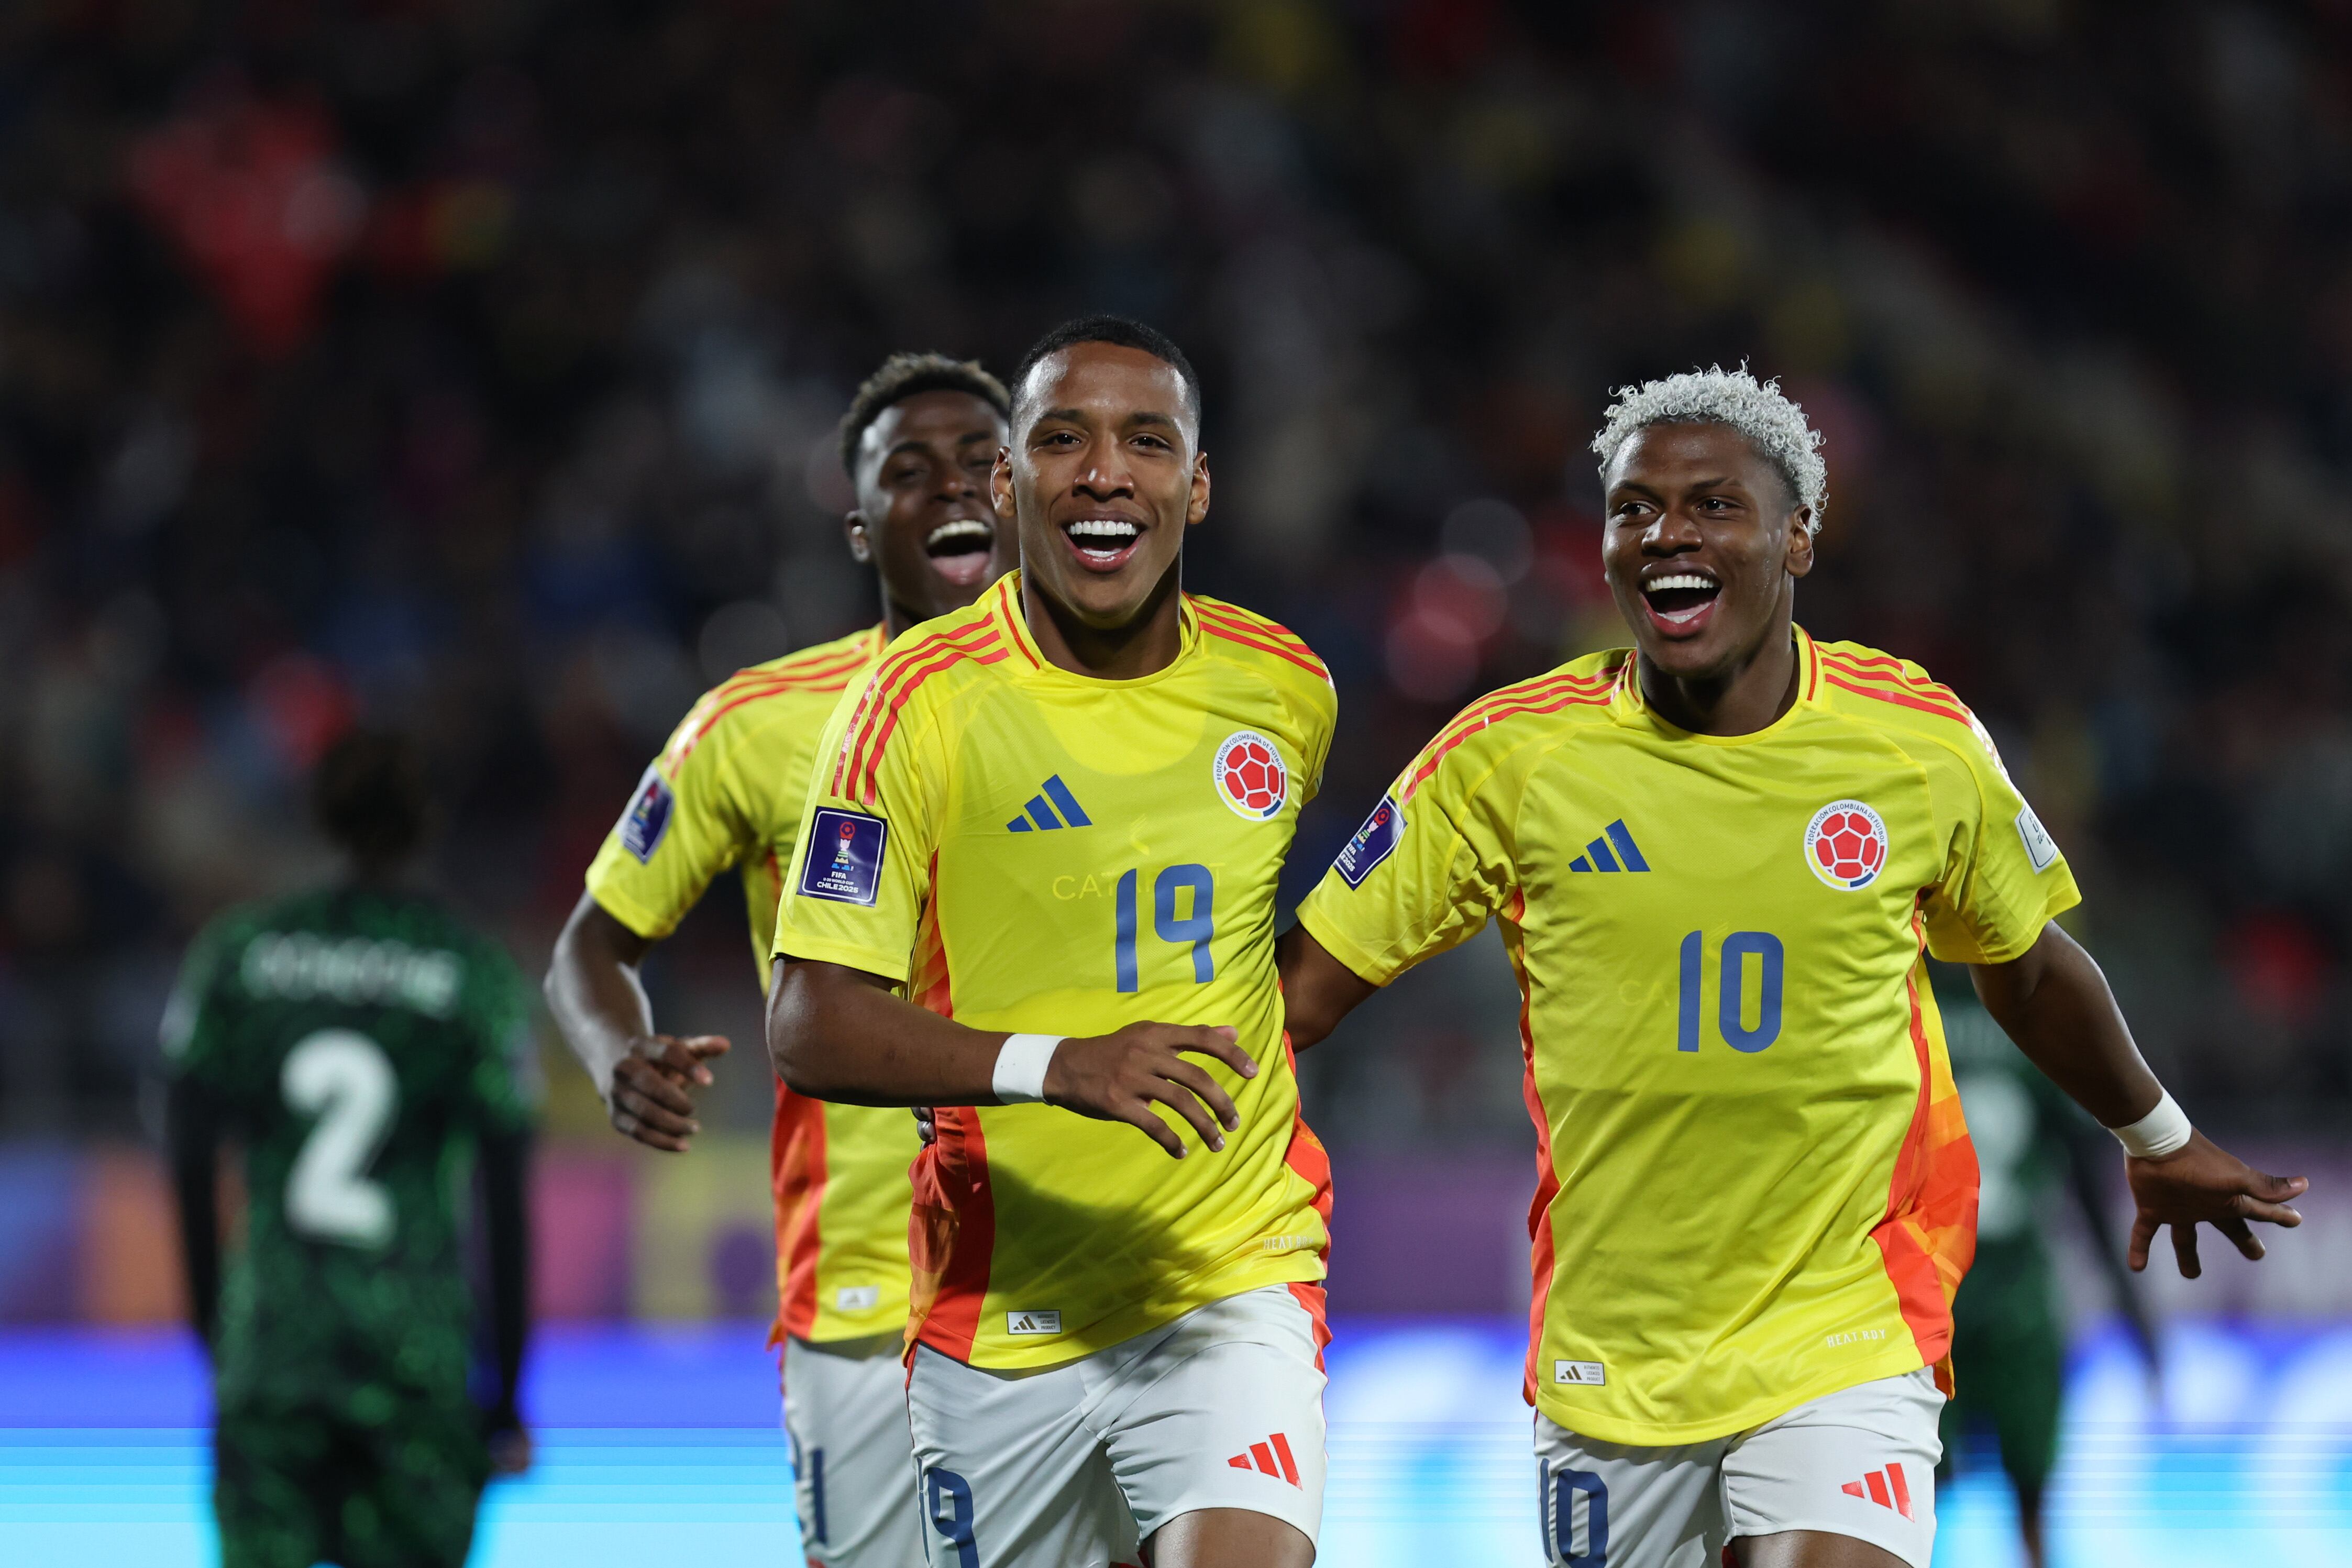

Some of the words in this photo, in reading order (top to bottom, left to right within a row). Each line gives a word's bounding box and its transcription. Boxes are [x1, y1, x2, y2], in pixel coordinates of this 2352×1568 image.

[1230, 734, 1262, 745] COLOMBIANA
[1829, 803, 1868, 814] COLOMBIANA
[831, 871, 846, 879] FIFA
[817, 881, 838, 890] CHILE
[838, 884, 858, 893] 2025
[1116, 864, 1213, 992] 19
[1677, 930, 1784, 1053] 10
[283, 1029, 398, 1247] 2
[1826, 1329, 1886, 1348] HEAT.RDY
[1540, 1457, 1609, 1568] 10
